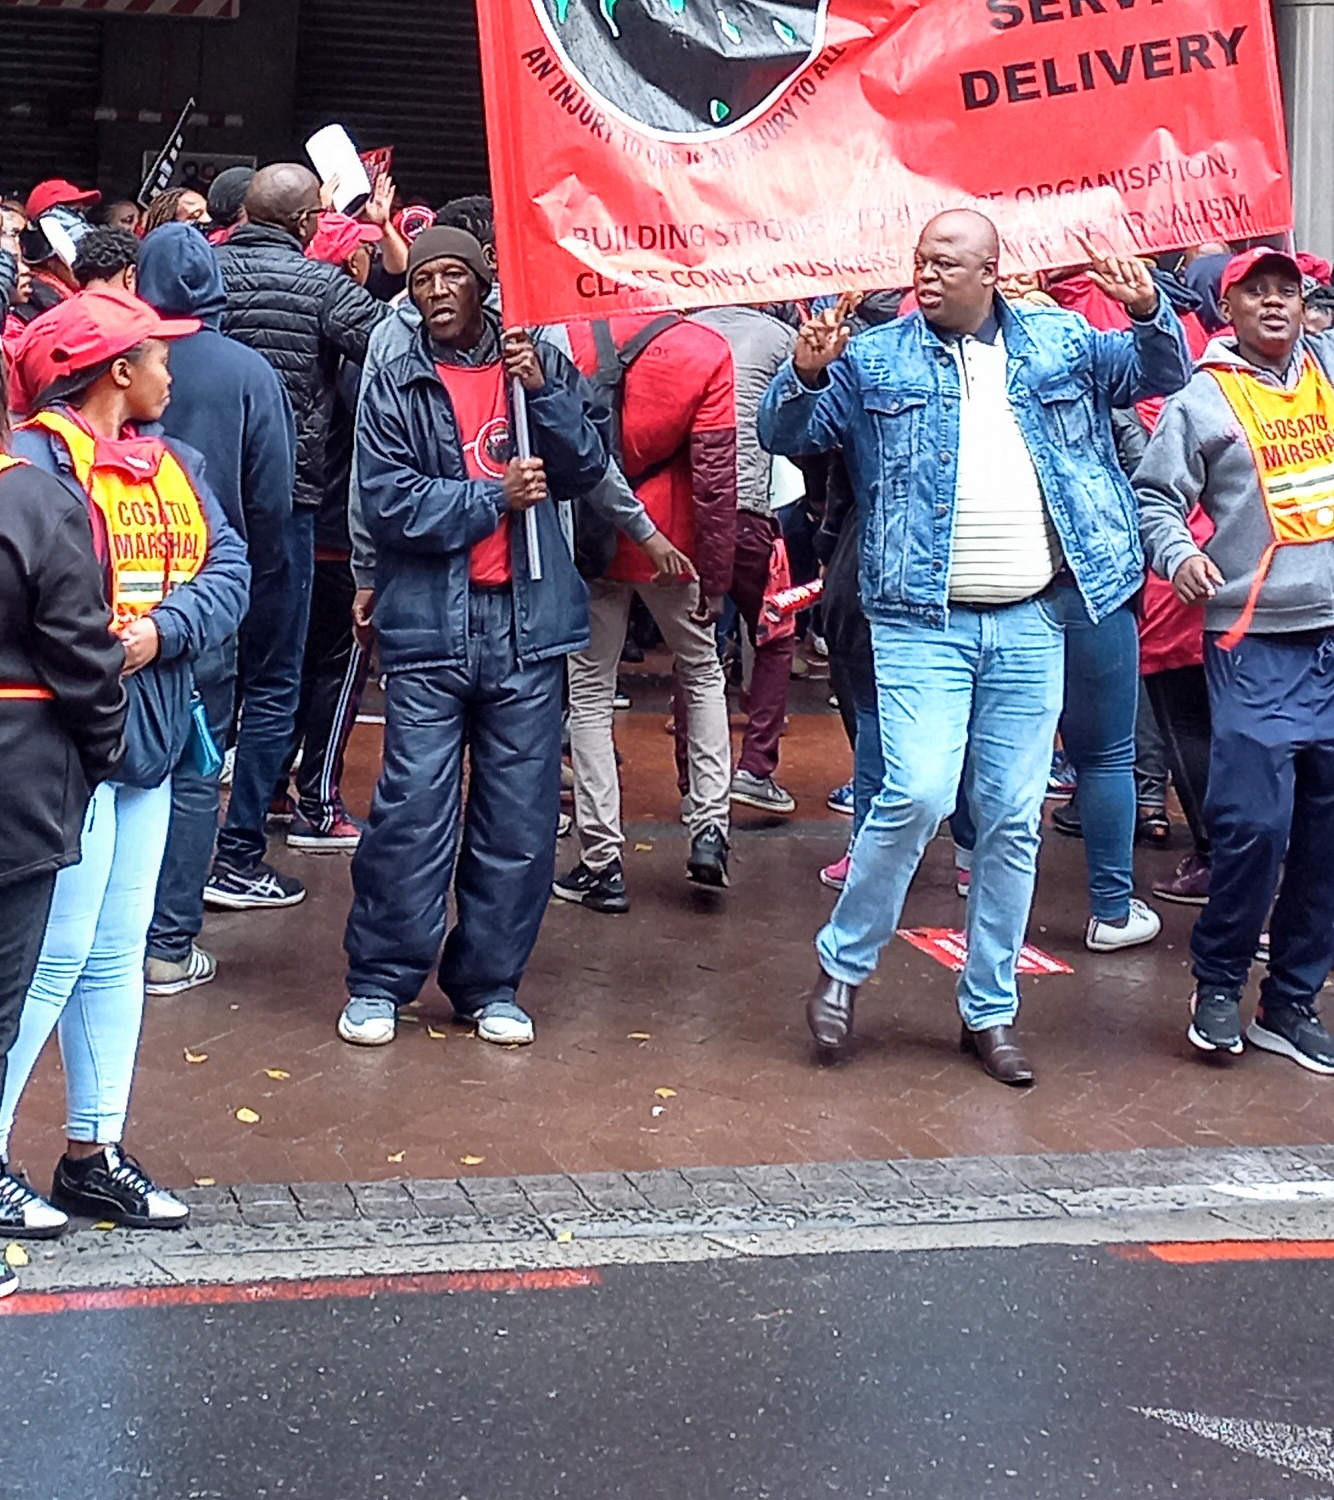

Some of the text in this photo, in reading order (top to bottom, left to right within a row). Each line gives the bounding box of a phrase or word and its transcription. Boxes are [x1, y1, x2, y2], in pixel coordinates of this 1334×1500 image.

[960, 25, 1248, 110] DELIVERY
[521, 46, 559, 82] AN
[548, 77, 613, 144] INJURY
[744, 103, 799, 160] INJURY
[791, 78, 818, 106] TO
[812, 44, 848, 81] ALL
[572, 223, 707, 253] BUILDING
[117, 500, 192, 527] COSTU
[113, 531, 199, 560] MARSHAL
